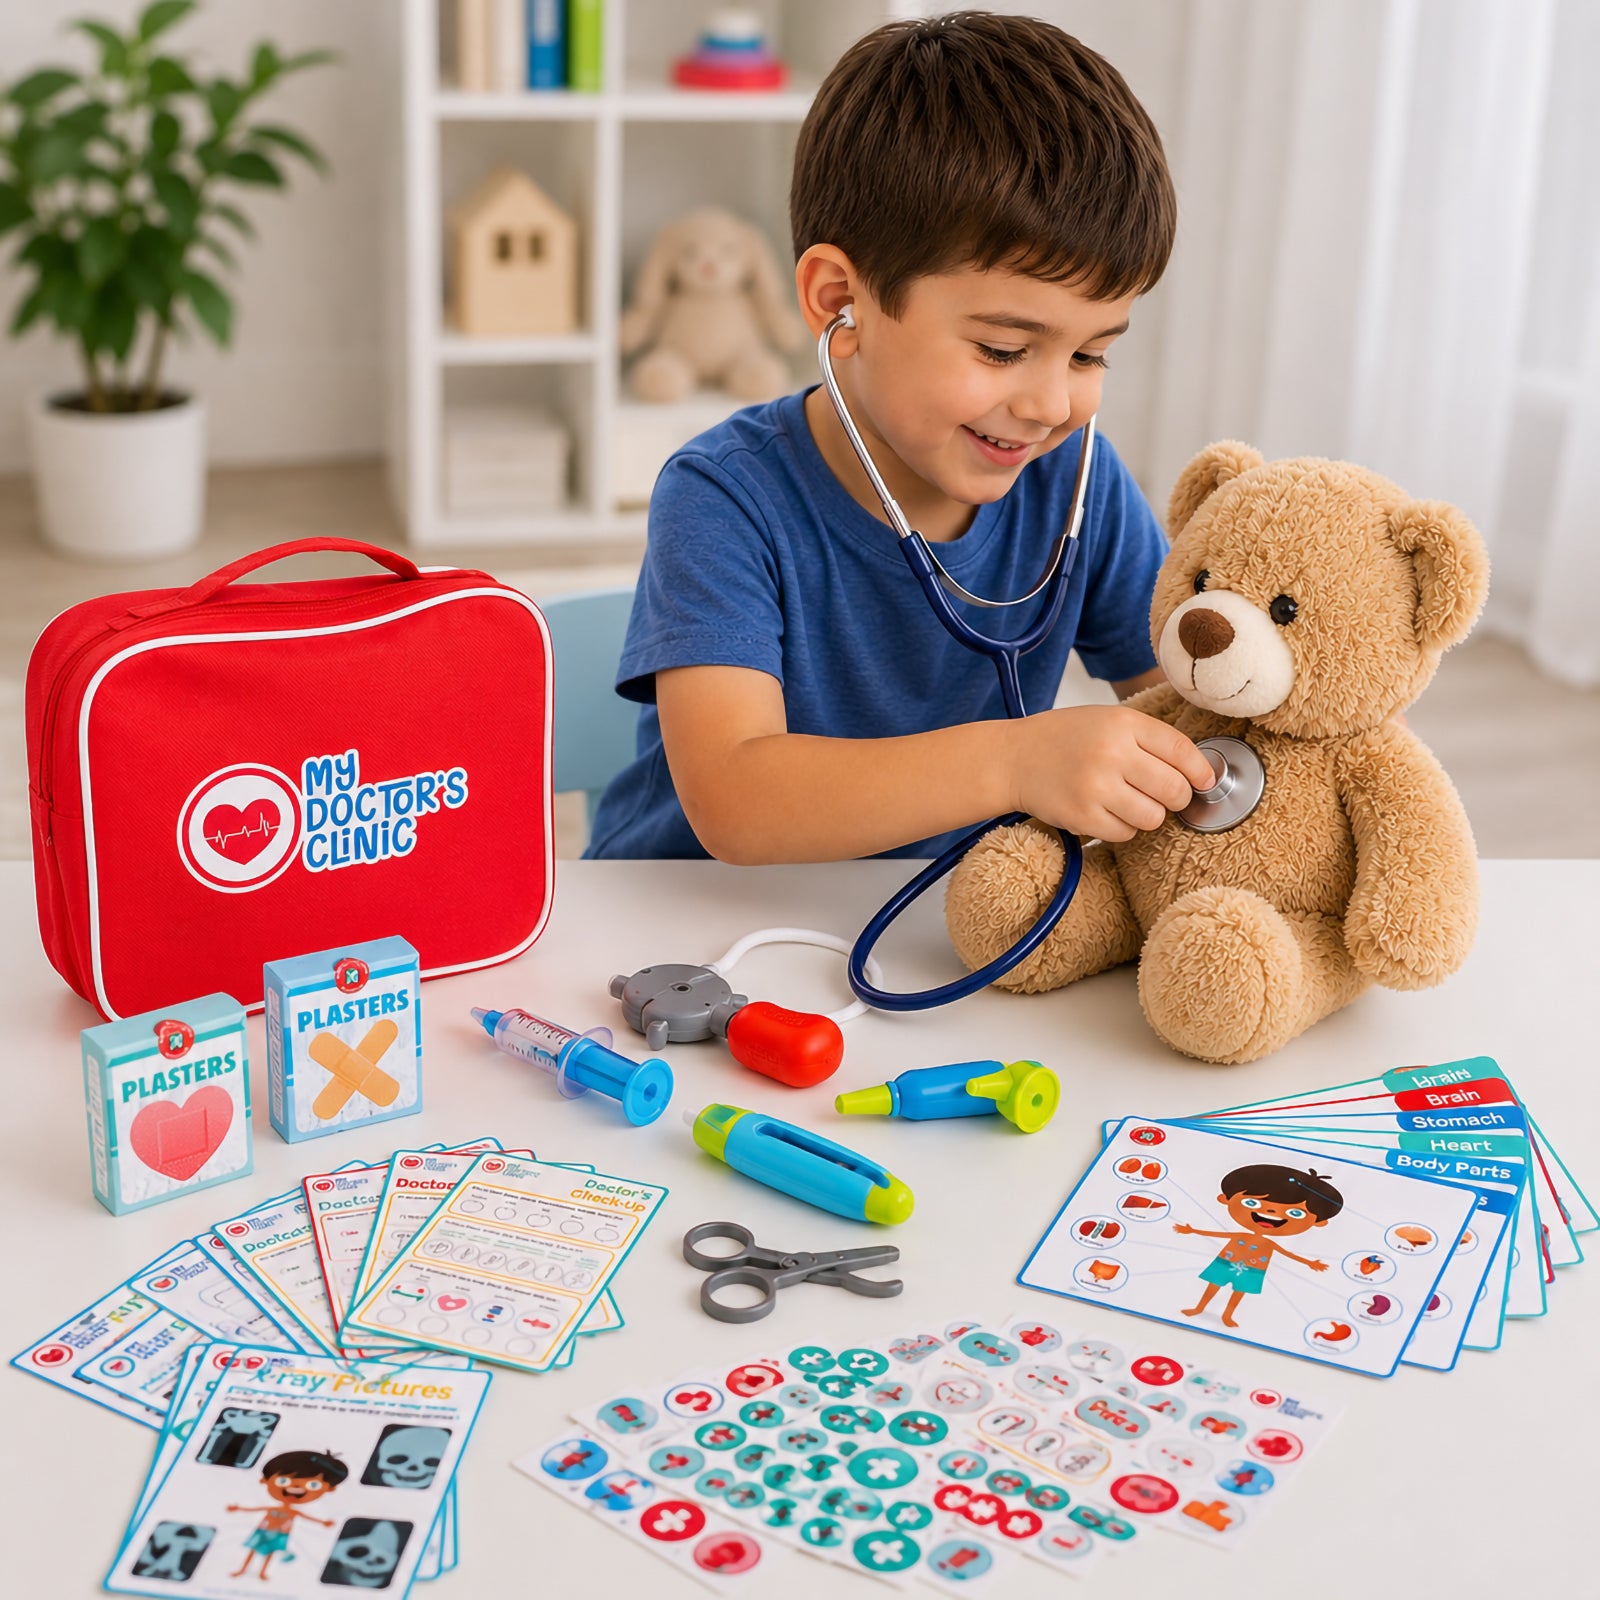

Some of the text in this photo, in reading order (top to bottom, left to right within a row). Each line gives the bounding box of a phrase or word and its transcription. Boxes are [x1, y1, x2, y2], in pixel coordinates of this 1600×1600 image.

[306, 770, 465, 833] DOCTOR'S
[297, 988, 410, 1033] PLASTERS
[121, 1051, 237, 1103] PLASTERS
[1425, 1090, 1481, 1106] Brain
[1412, 1112, 1505, 1129] Stomach
[1430, 1139, 1492, 1152] Heart
[1396, 1154, 1511, 1179] Body Parts
[332, 1374, 454, 1400] Pictures
